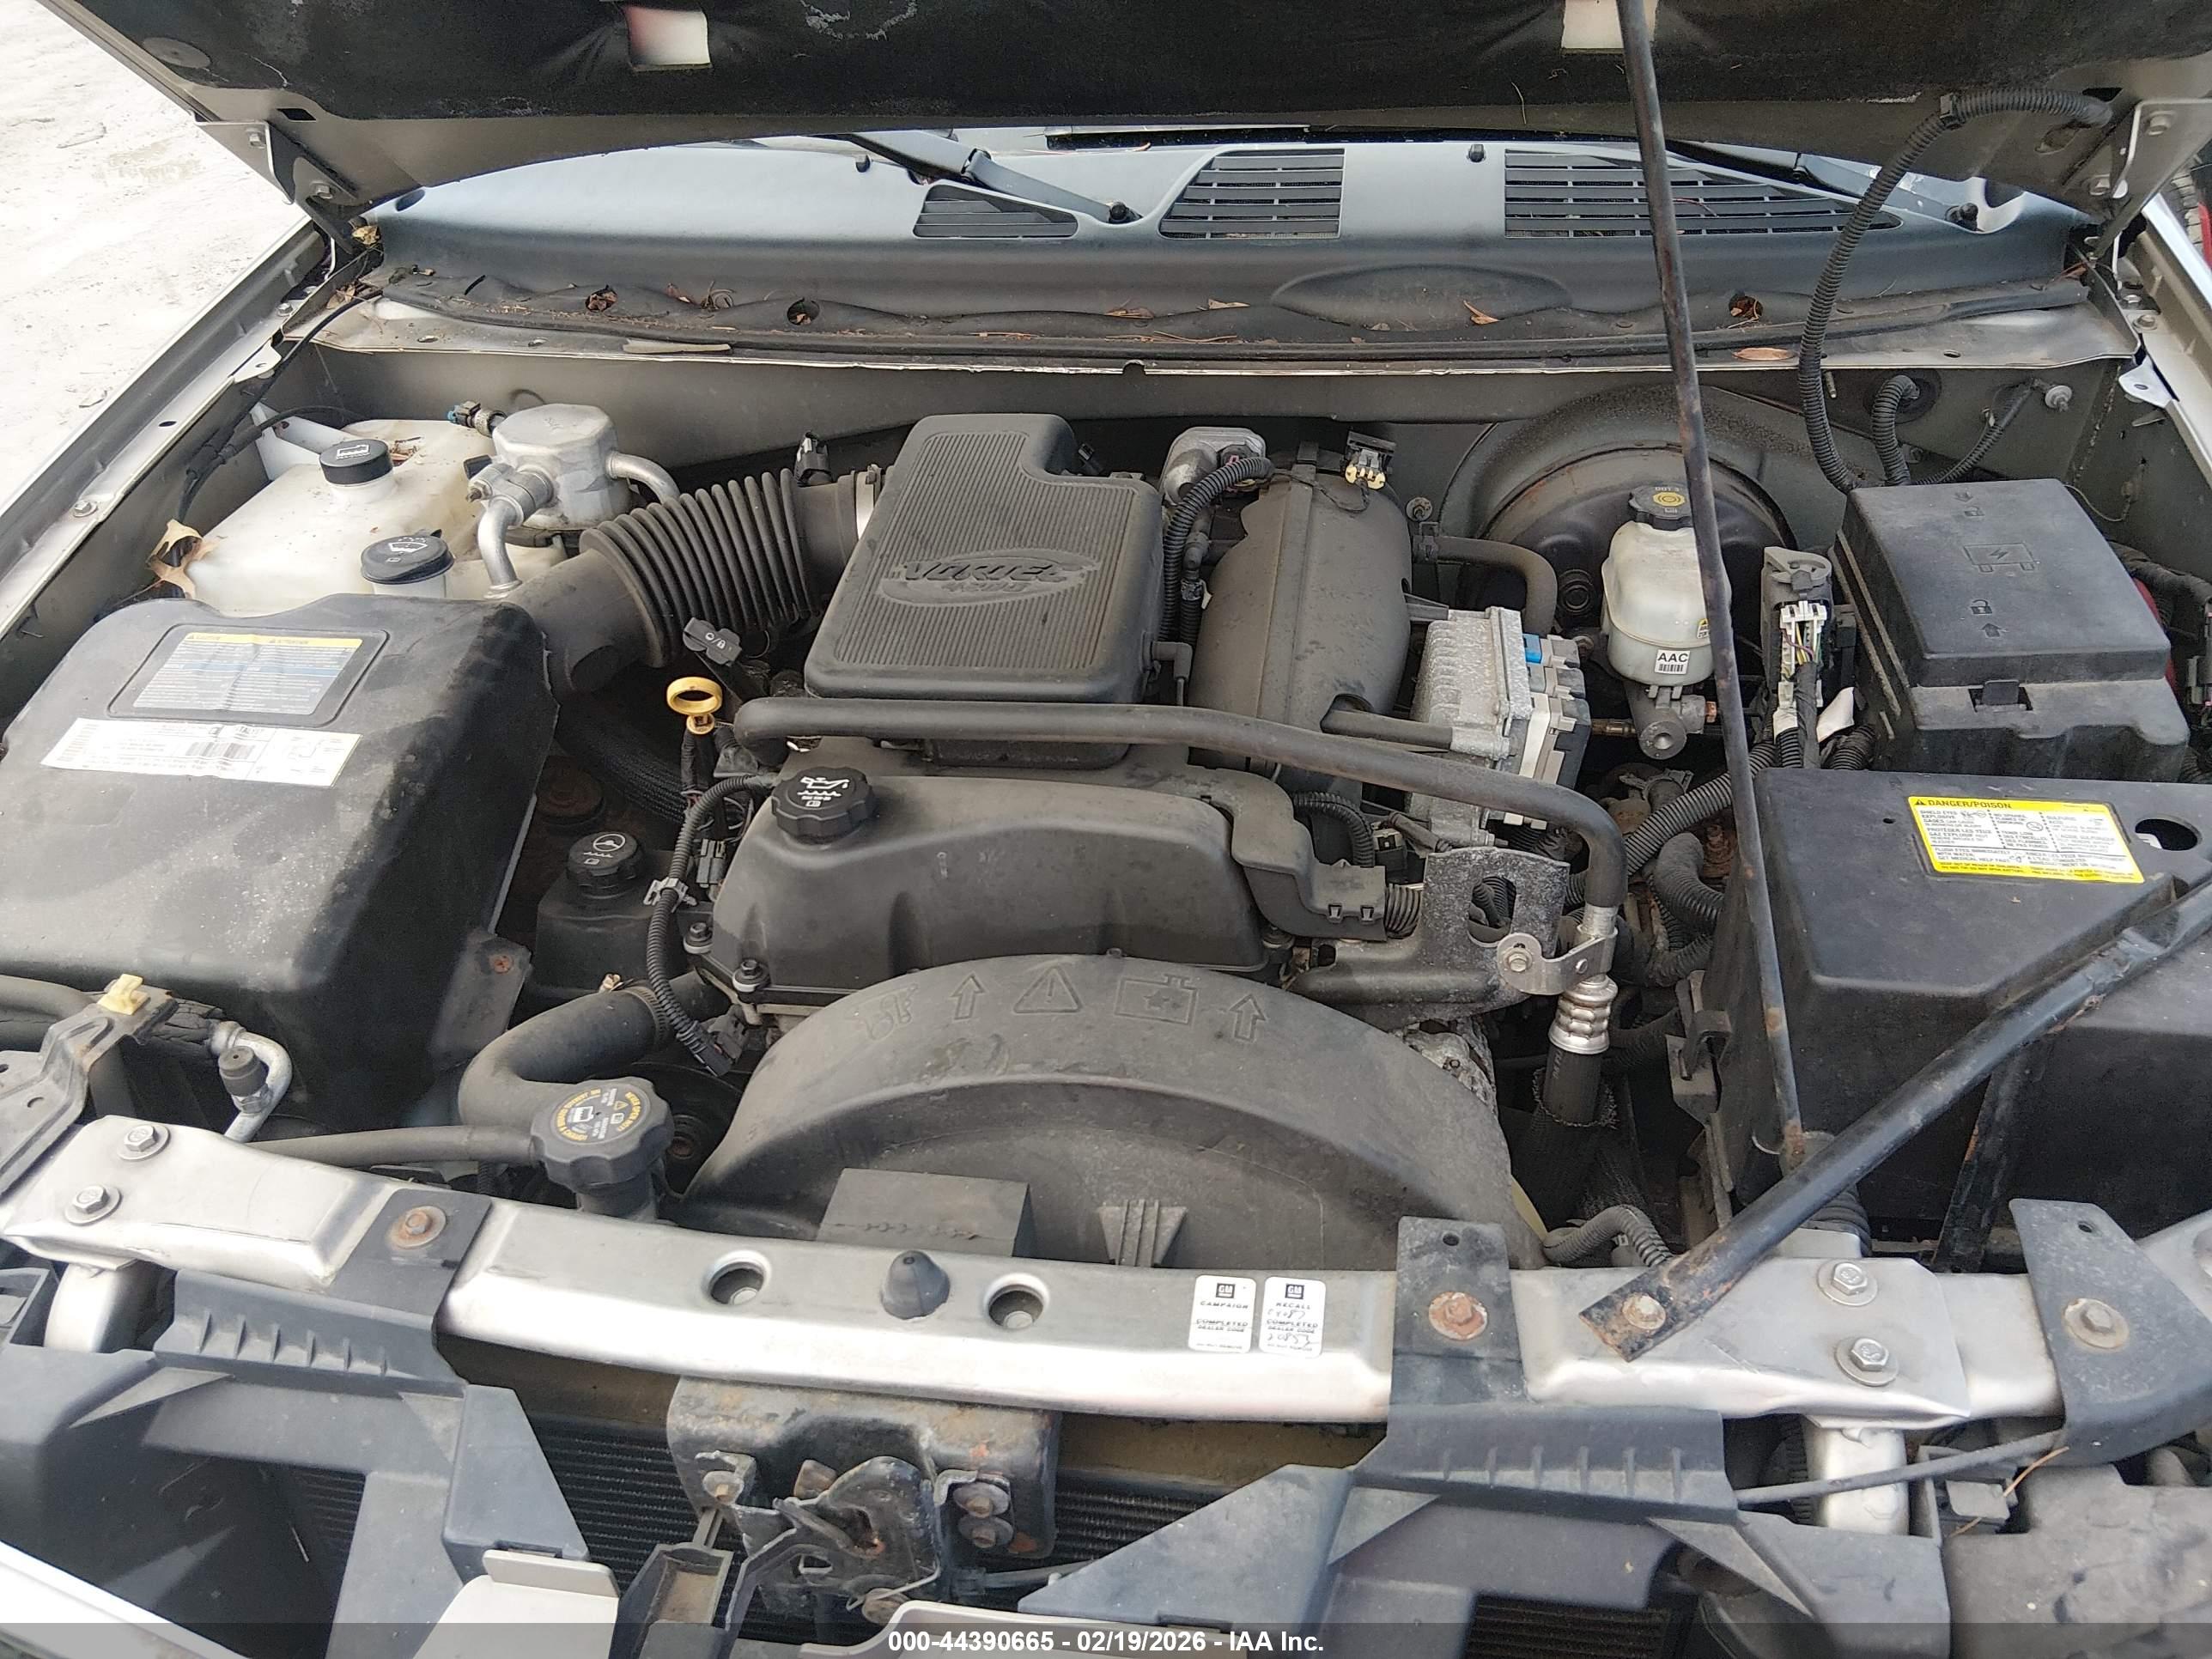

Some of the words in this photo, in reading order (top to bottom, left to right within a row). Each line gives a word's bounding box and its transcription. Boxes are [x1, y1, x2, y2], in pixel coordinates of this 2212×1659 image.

[905, 562, 1067, 582] VORTEC
[1657, 652, 1689, 663] AAC
[1927, 799, 2012, 809] DANGER/POISON
[1200, 1300, 1249, 1309] CAMPAIGN
[1196, 1318, 1249, 1327] COMPLETED
[1267, 1318, 1318, 1328] COMPLETED
